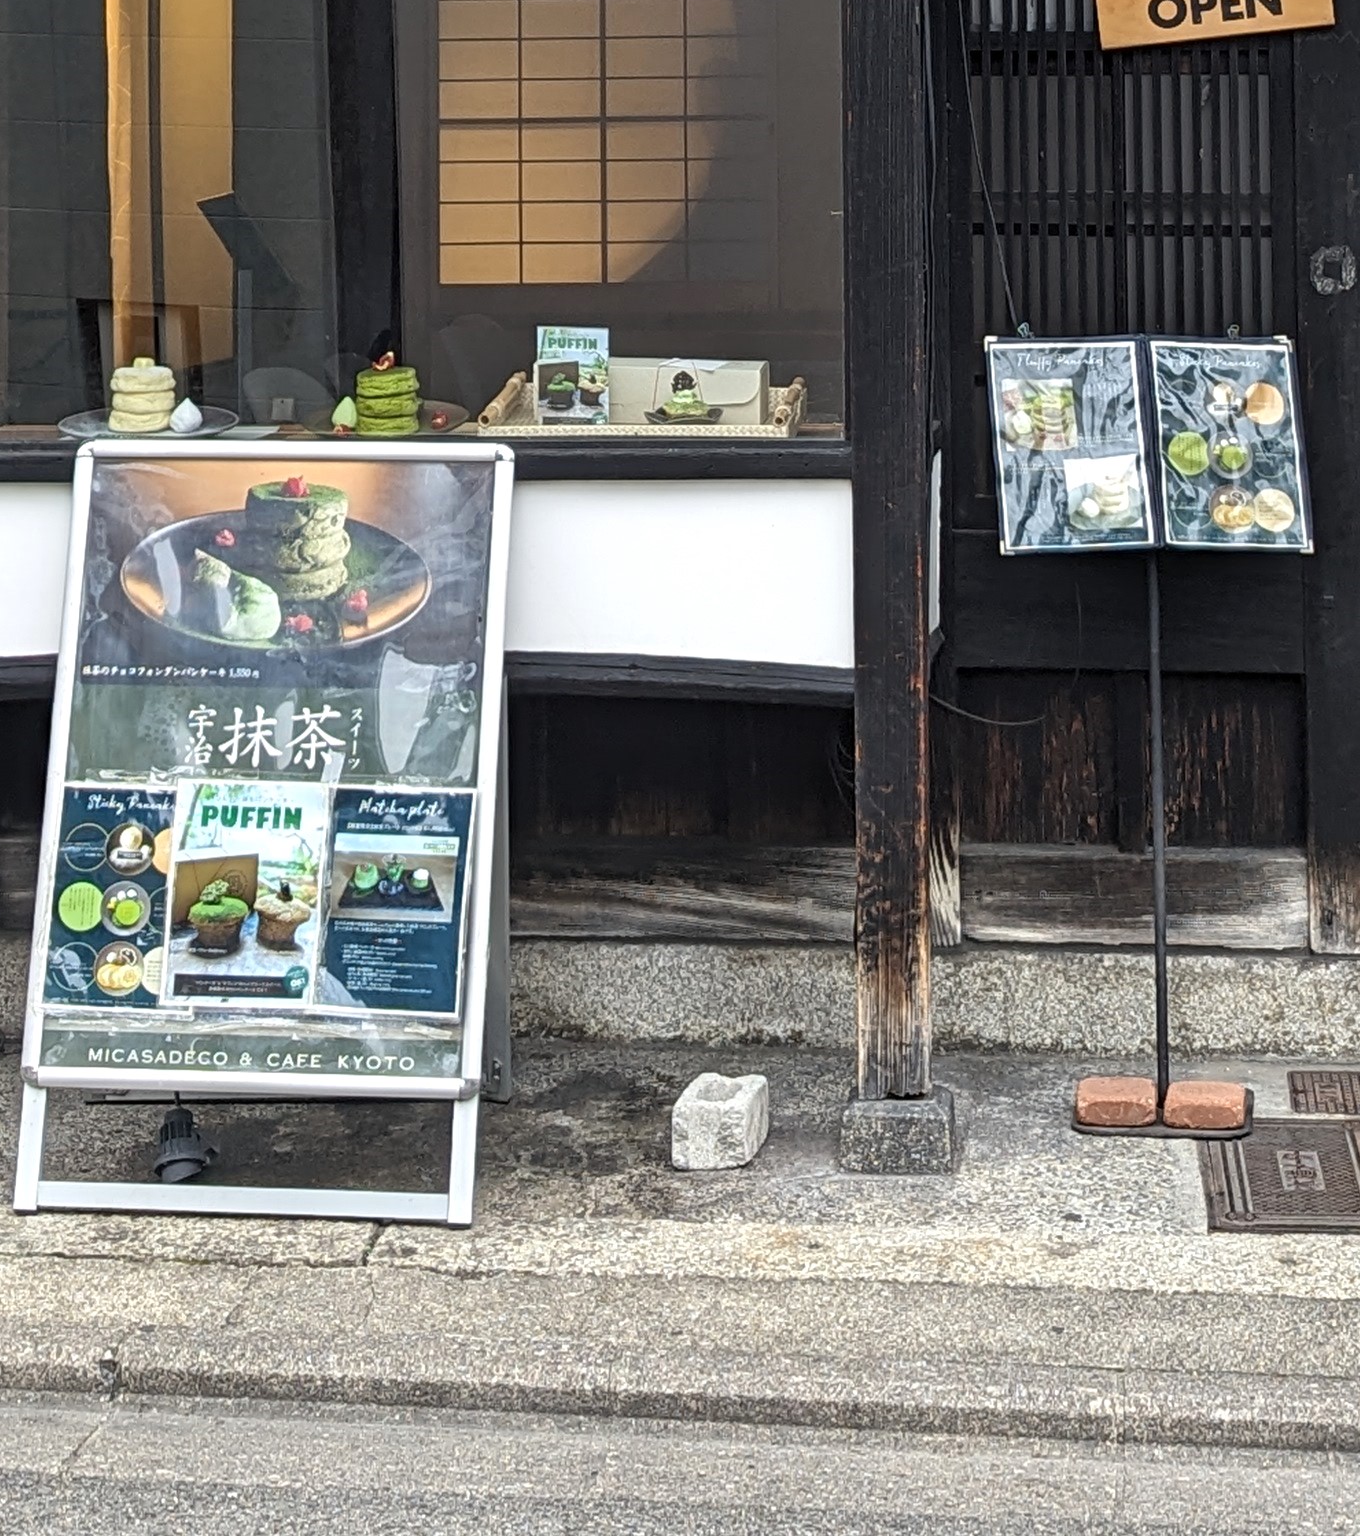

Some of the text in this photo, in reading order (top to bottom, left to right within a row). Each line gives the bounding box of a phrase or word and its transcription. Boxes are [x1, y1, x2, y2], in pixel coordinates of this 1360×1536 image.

[547, 337, 598, 350] PUFFIN
[184, 704, 363, 770] 宇治 抹茶 スイーツ
[87, 793, 126, 815] Sticky
[200, 804, 303, 830] PUFFIN
[87, 1048, 416, 1072] MICASADECO & CAFE KYOTO
